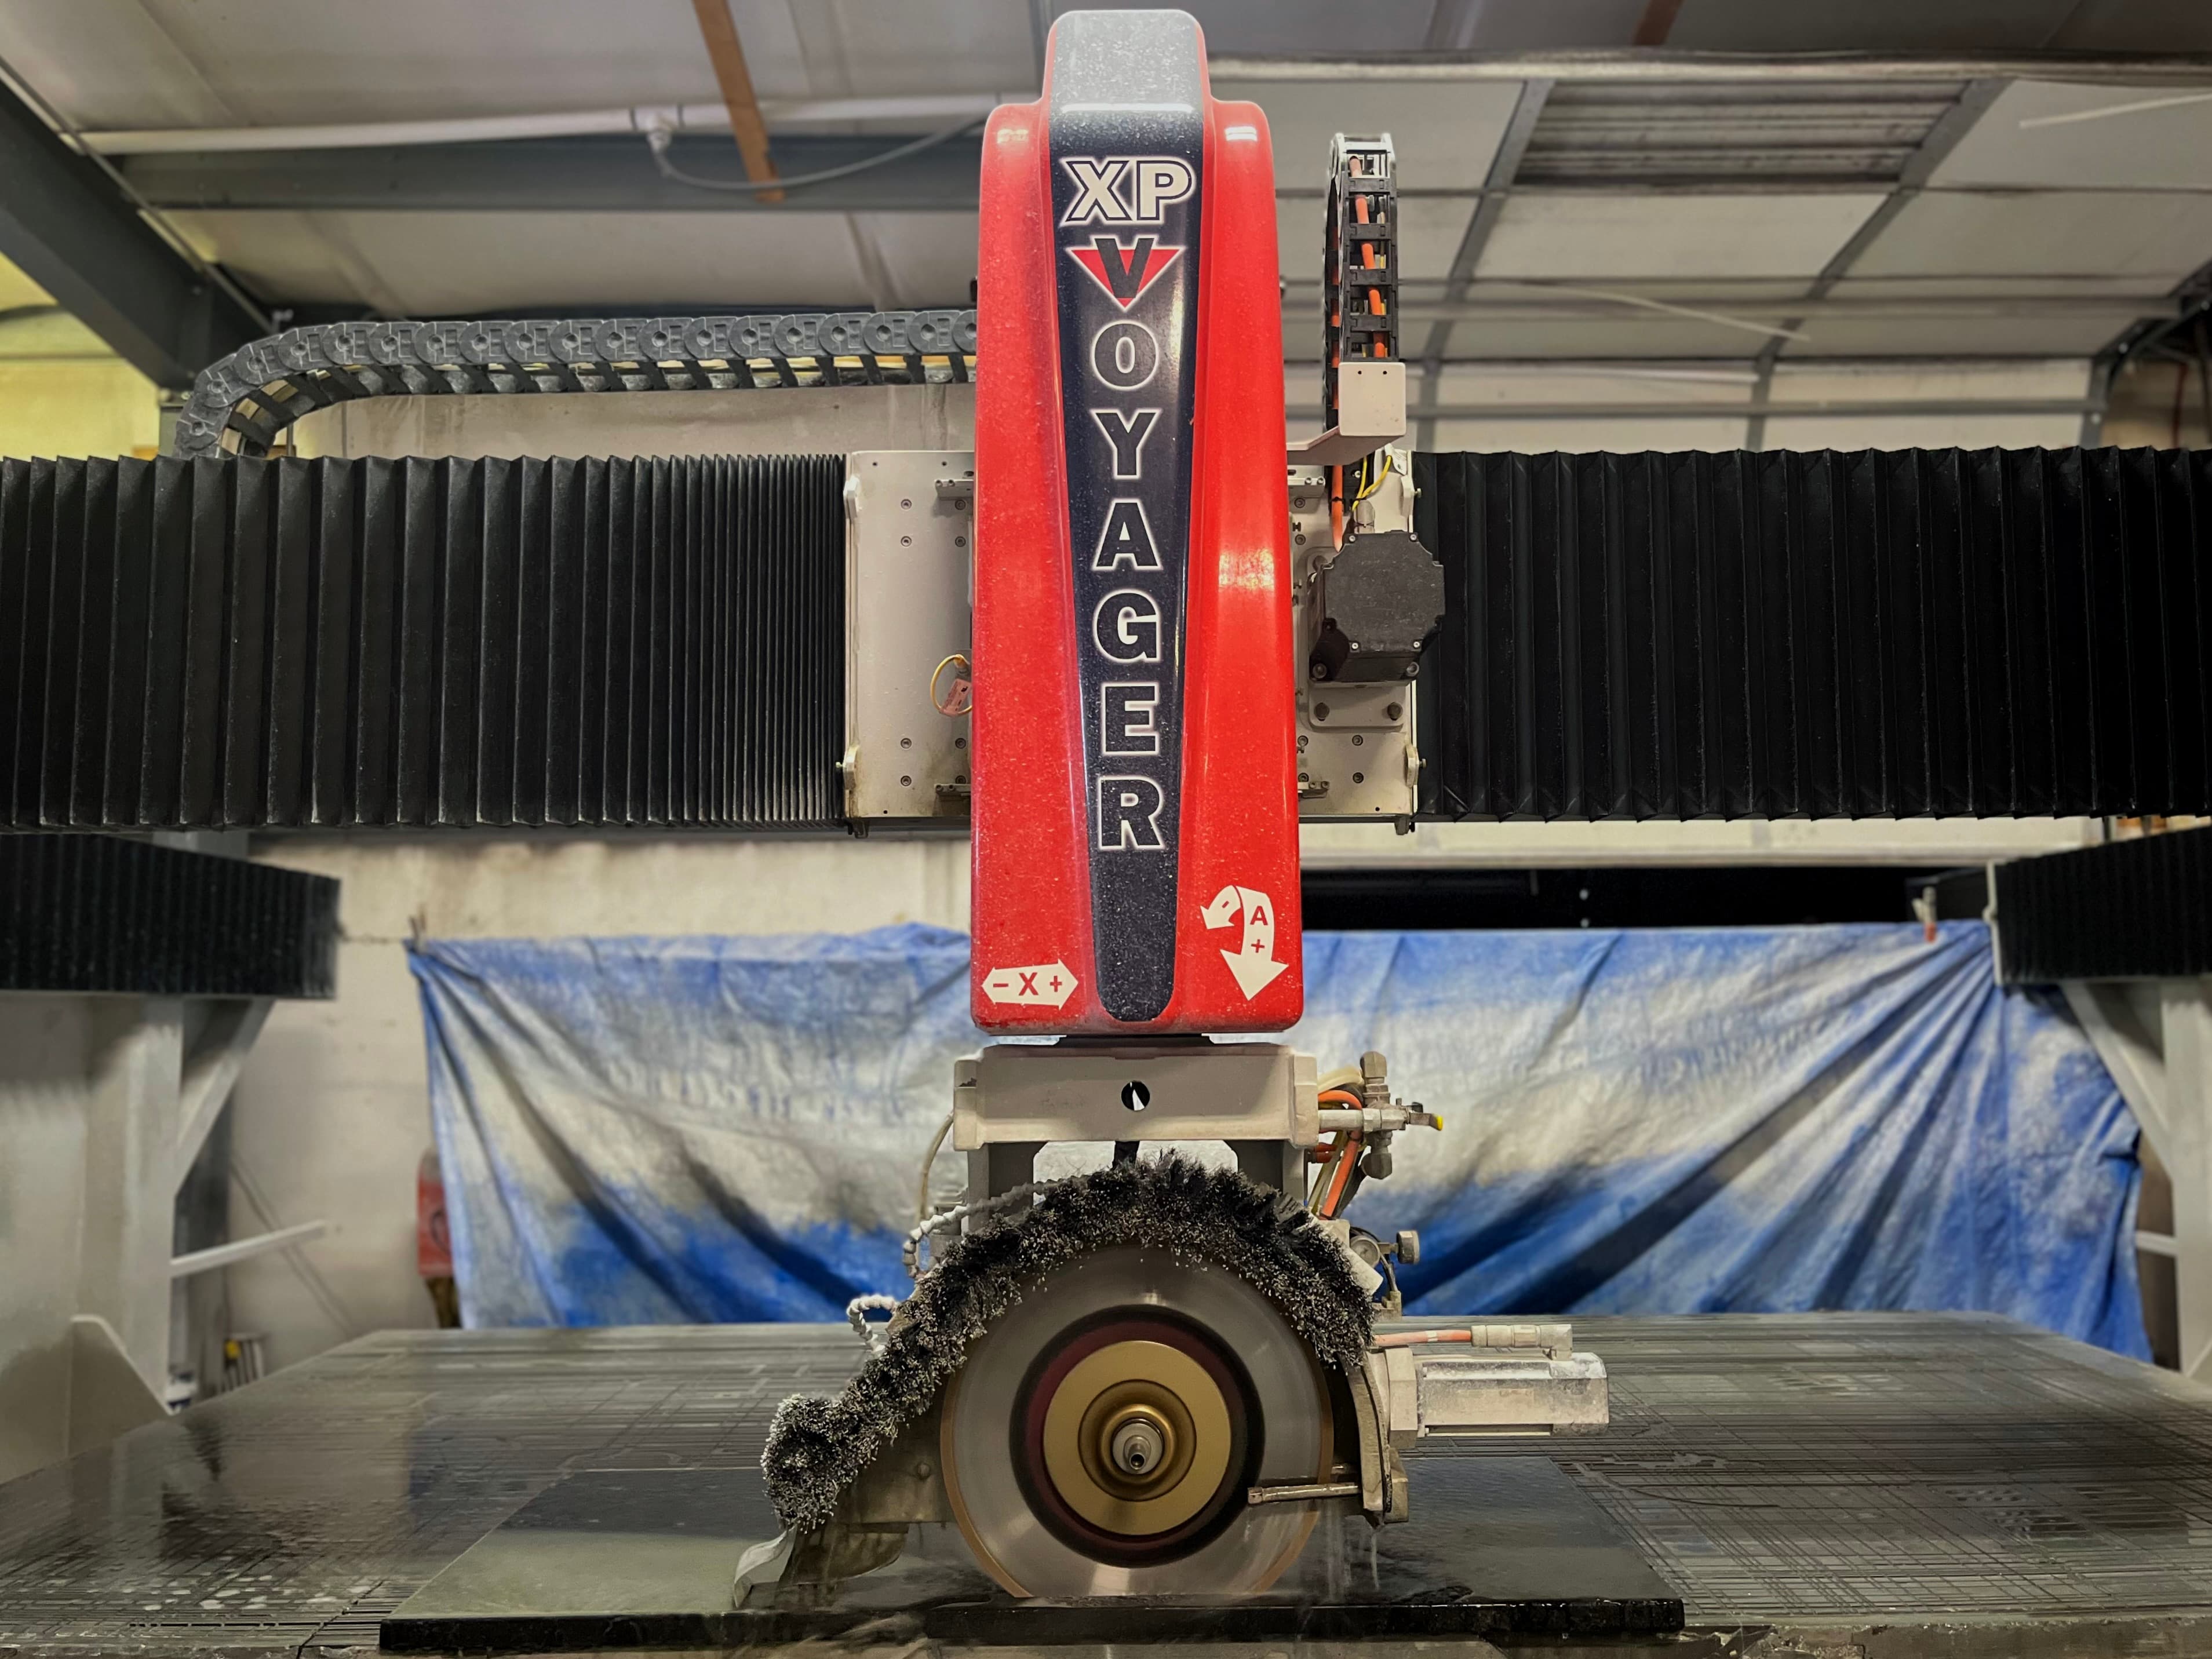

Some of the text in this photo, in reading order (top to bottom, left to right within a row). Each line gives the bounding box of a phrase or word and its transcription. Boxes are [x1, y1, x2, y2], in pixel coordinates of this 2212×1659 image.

[1060, 158, 1195, 226] XP
[1091, 235, 1164, 850] VOYAGER
[1250, 906, 1268, 925] A
